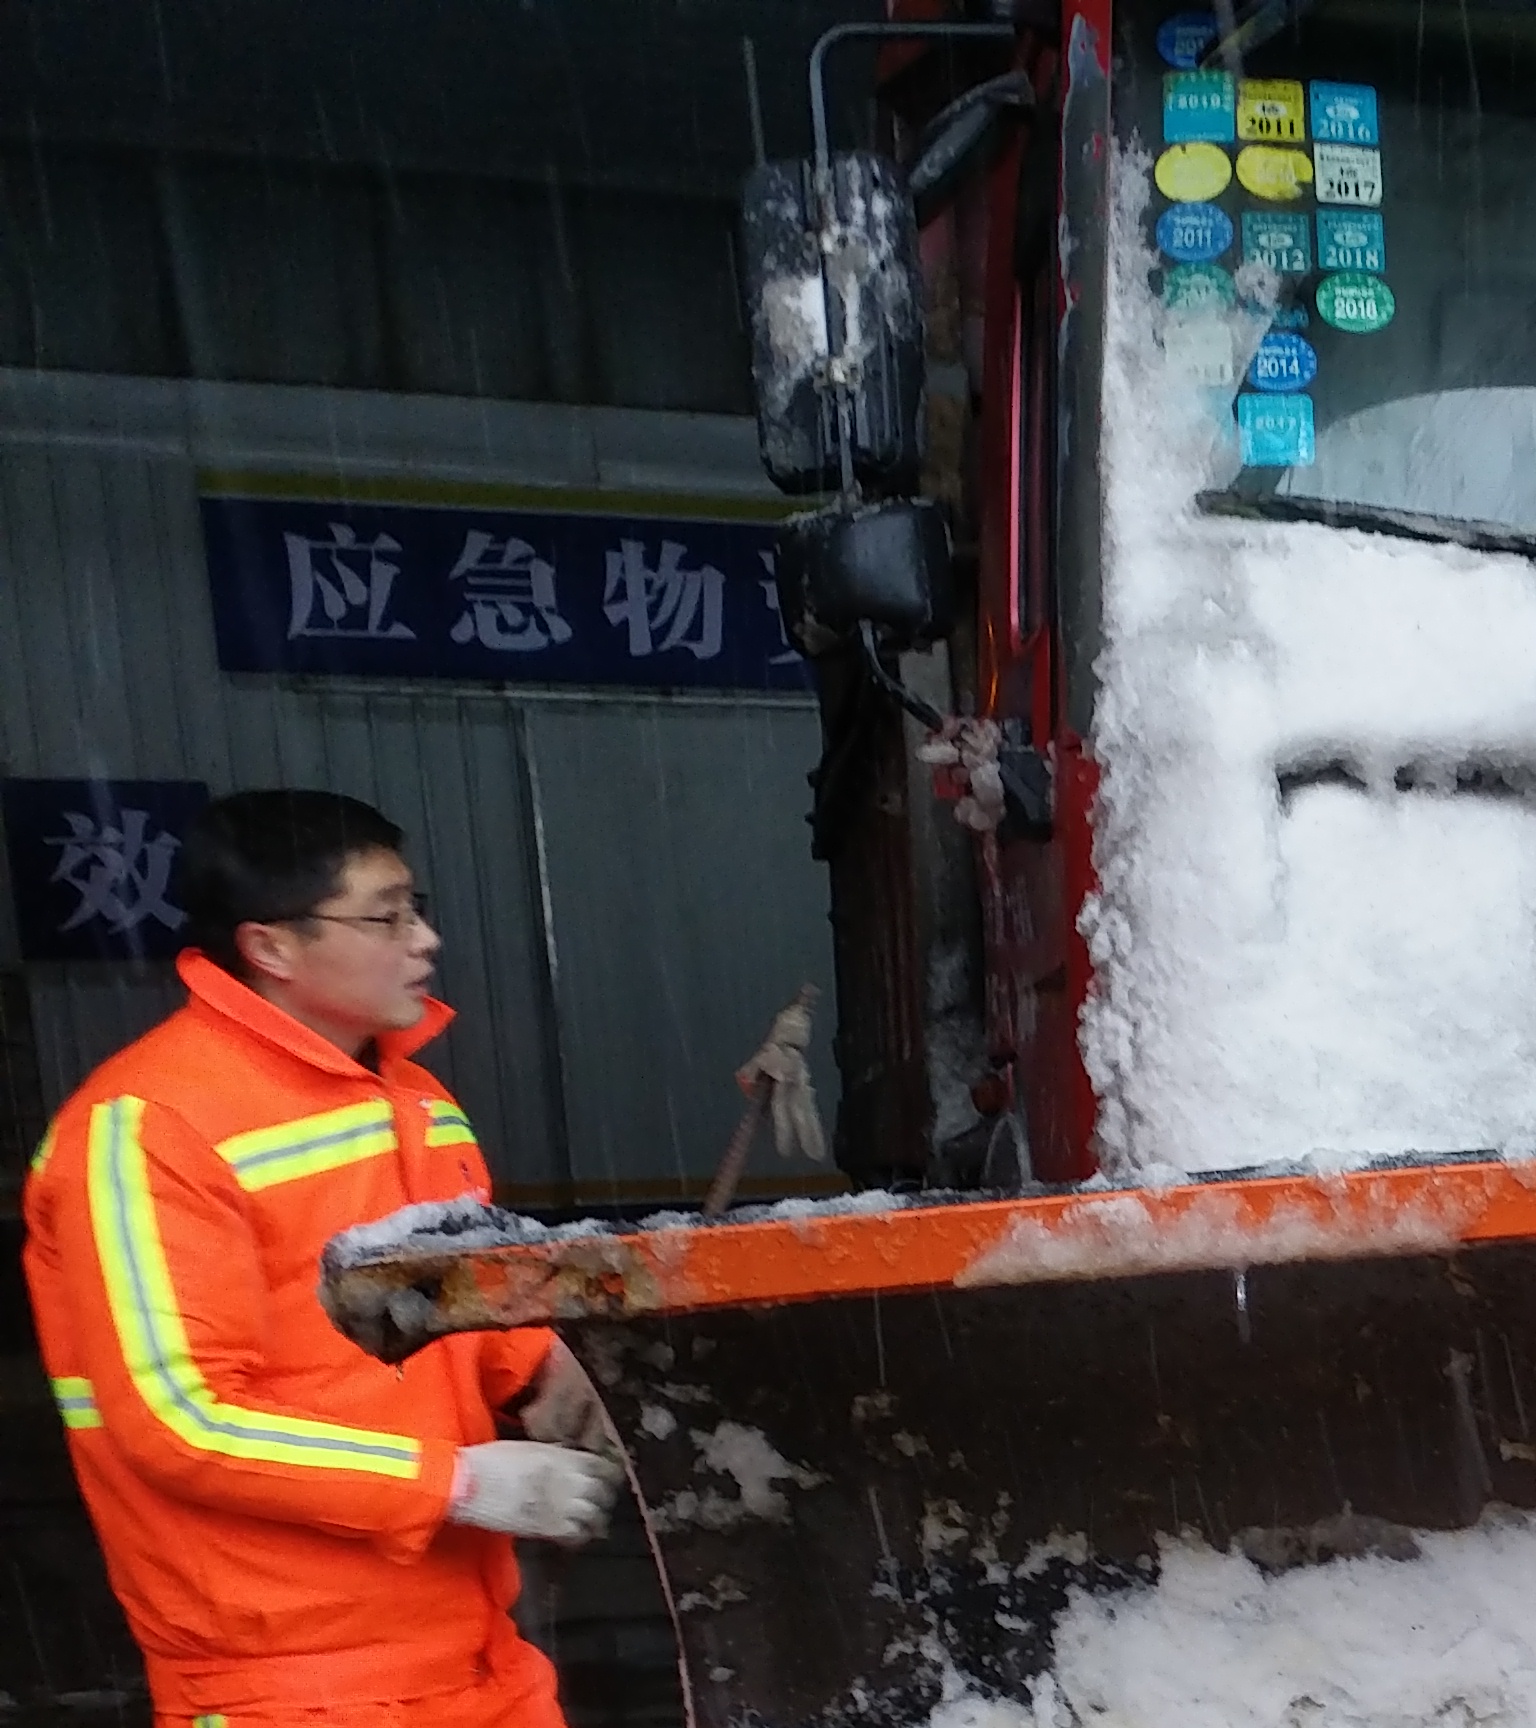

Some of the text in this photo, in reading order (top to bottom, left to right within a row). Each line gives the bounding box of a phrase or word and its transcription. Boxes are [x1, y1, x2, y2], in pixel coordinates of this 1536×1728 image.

[1247, 116, 1295, 138] 2011
[1318, 118, 1371, 142] 2016
[1325, 178, 1376, 200] 2017
[1173, 226, 1212, 249] 2011
[1257, 355, 1300, 379] 2014
[283, 522, 804, 664] 应急物
